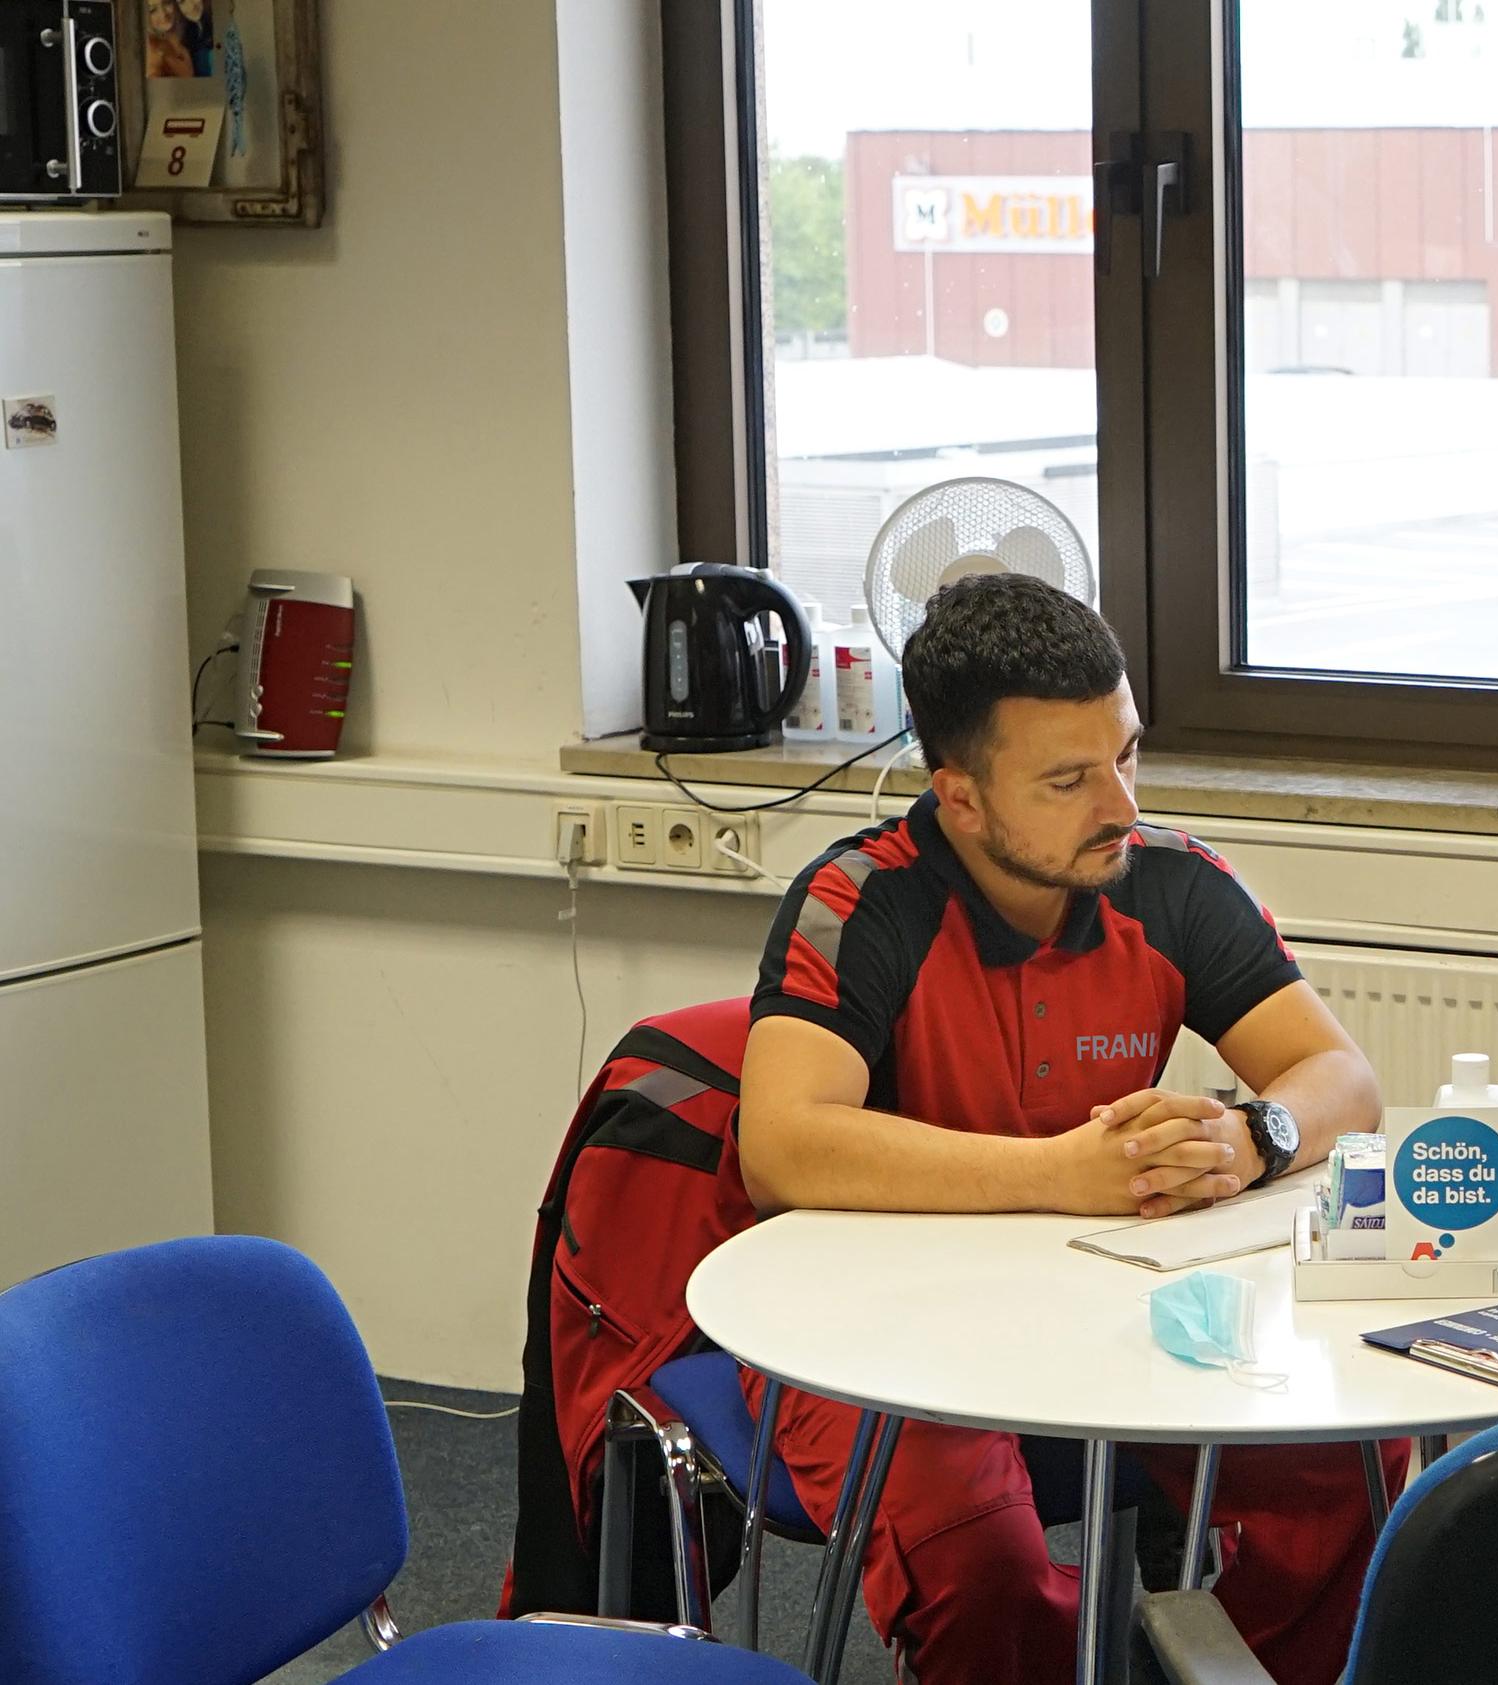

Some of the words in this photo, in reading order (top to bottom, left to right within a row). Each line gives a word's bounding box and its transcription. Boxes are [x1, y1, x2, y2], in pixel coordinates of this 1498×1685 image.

[168, 146, 187, 176] 8
[917, 204, 936, 225] M
[960, 188, 1095, 240] Müll
[1412, 1142, 1488, 1163] Schön,
[1412, 1165, 1463, 1183] dass
[1469, 1165, 1496, 1182] du
[1412, 1186, 1440, 1205] da
[1445, 1186, 1491, 1204] bist.
